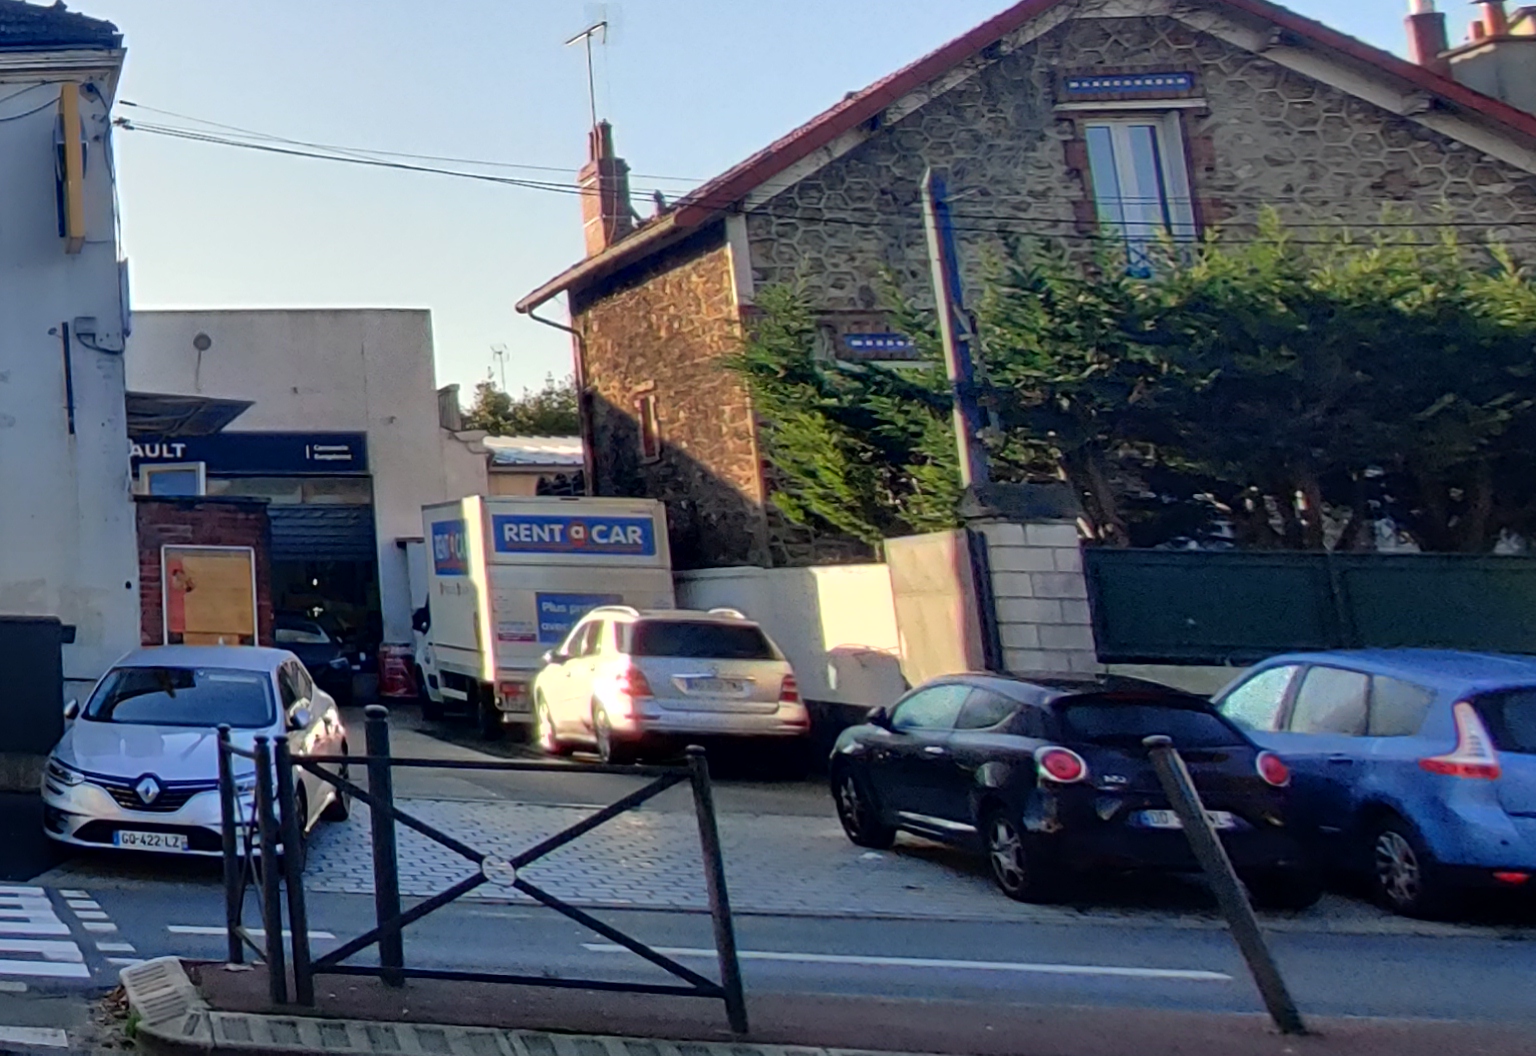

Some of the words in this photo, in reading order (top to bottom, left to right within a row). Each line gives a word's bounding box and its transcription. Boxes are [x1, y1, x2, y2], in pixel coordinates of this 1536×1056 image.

[129, 443, 186, 458] AULT
[503, 523, 564, 542] RENT
[591, 525, 643, 544] CAR
[541, 601, 567, 613] Plus
